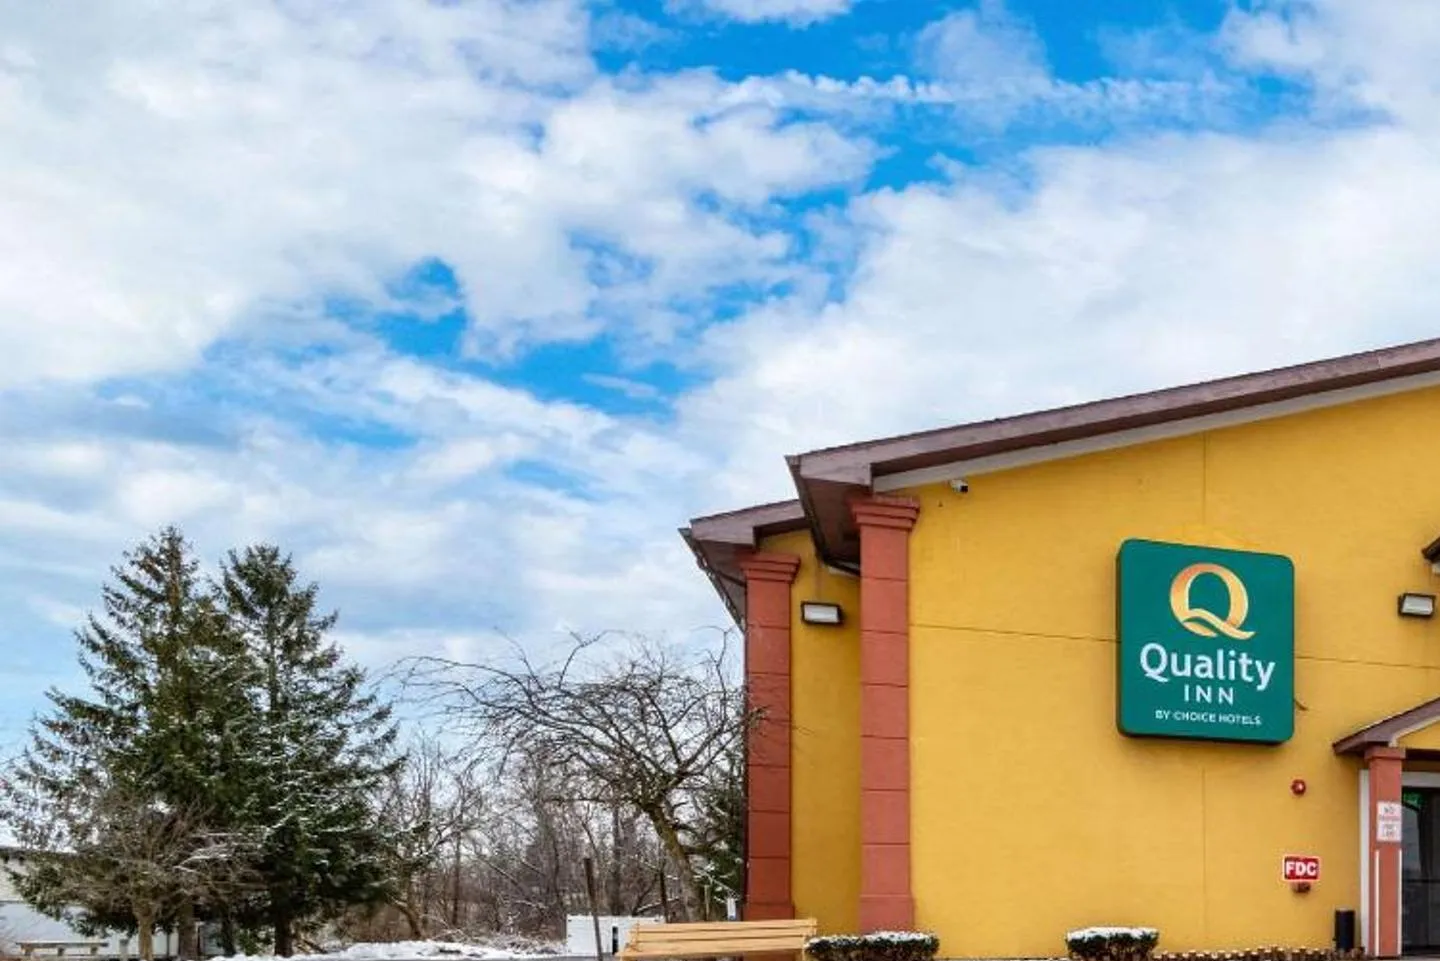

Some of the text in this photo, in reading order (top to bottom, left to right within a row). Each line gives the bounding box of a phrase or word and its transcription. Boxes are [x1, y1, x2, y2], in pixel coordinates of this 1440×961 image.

[1169, 562, 1256, 640] Q
[1139, 642, 1276, 691] Quality
[1184, 684, 1234, 705] INN
[1155, 709, 1262, 726] BY CHOICE HOTELS
[1285, 860, 1317, 877] FDC
